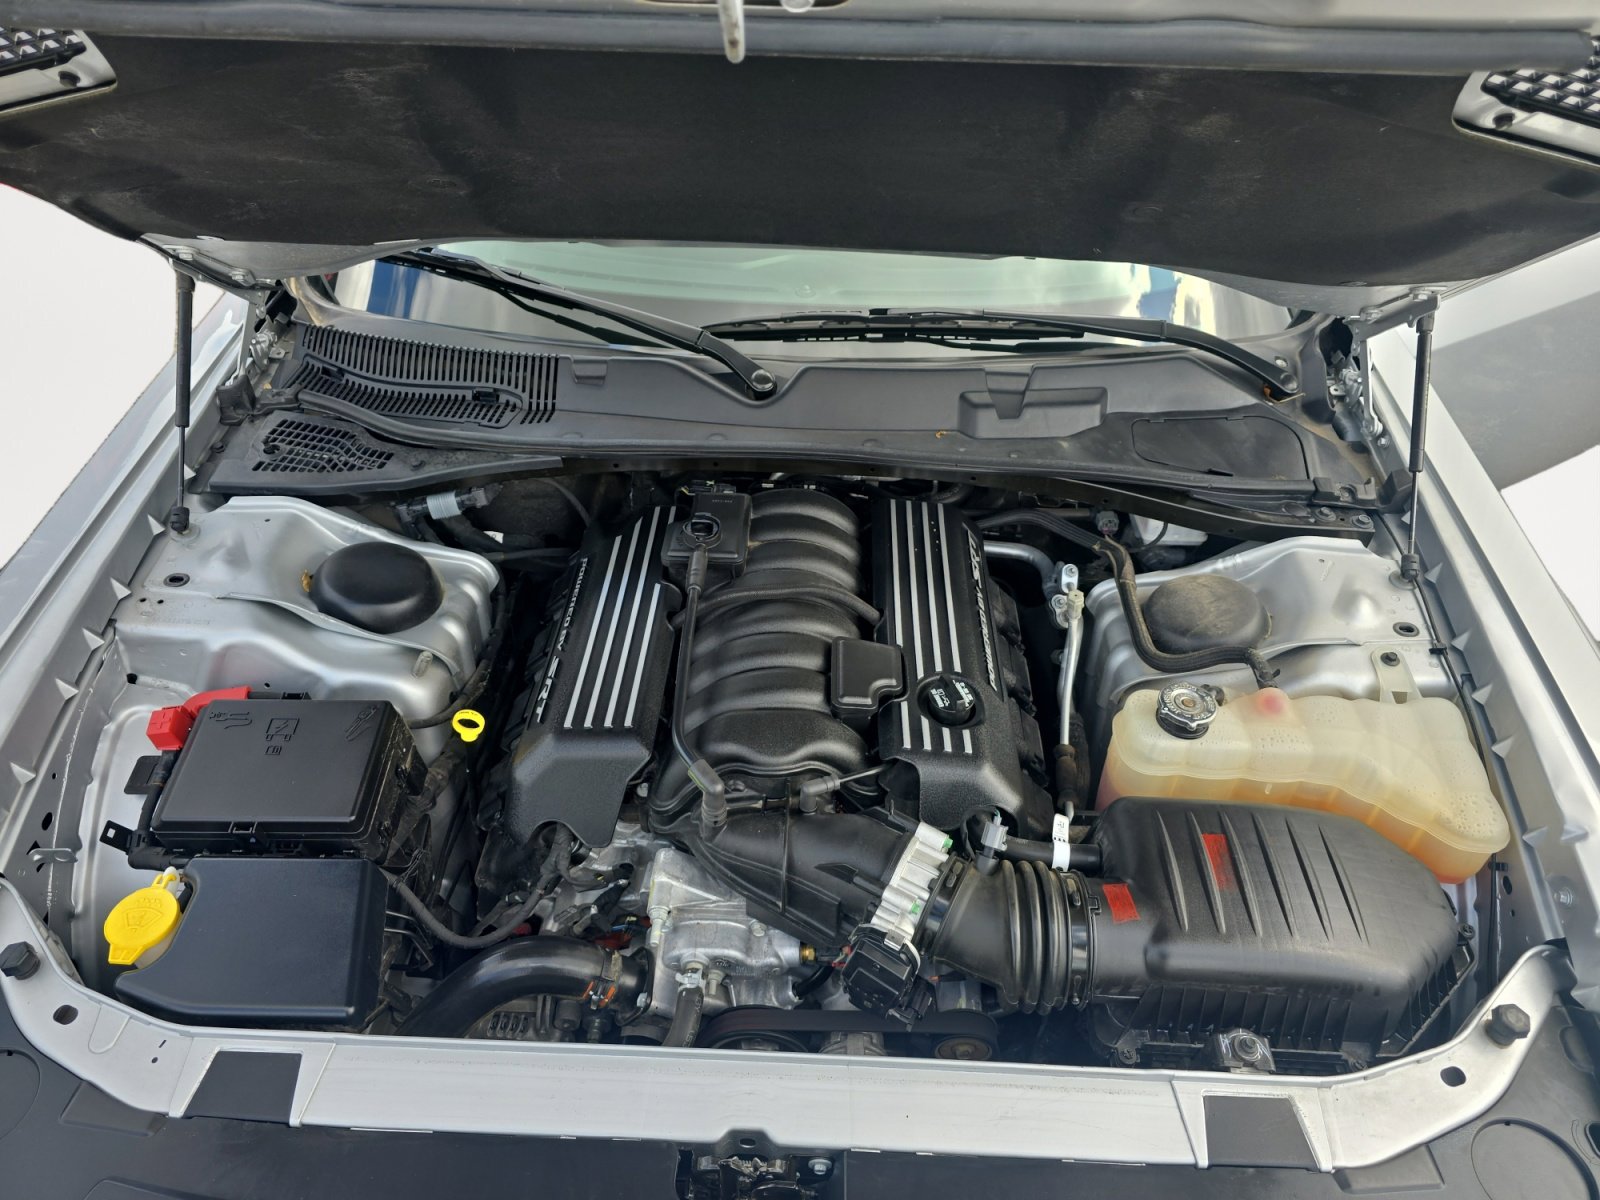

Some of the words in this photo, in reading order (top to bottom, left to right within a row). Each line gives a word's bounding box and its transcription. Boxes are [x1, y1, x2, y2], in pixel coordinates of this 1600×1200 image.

[967, 529, 982, 589] SRT
[564, 557, 588, 627] POWERED
[976, 585, 985, 611] BY
[557, 629, 568, 651] BY
[979, 609, 997, 692] POWERED
[535, 655, 560, 723] SRT
